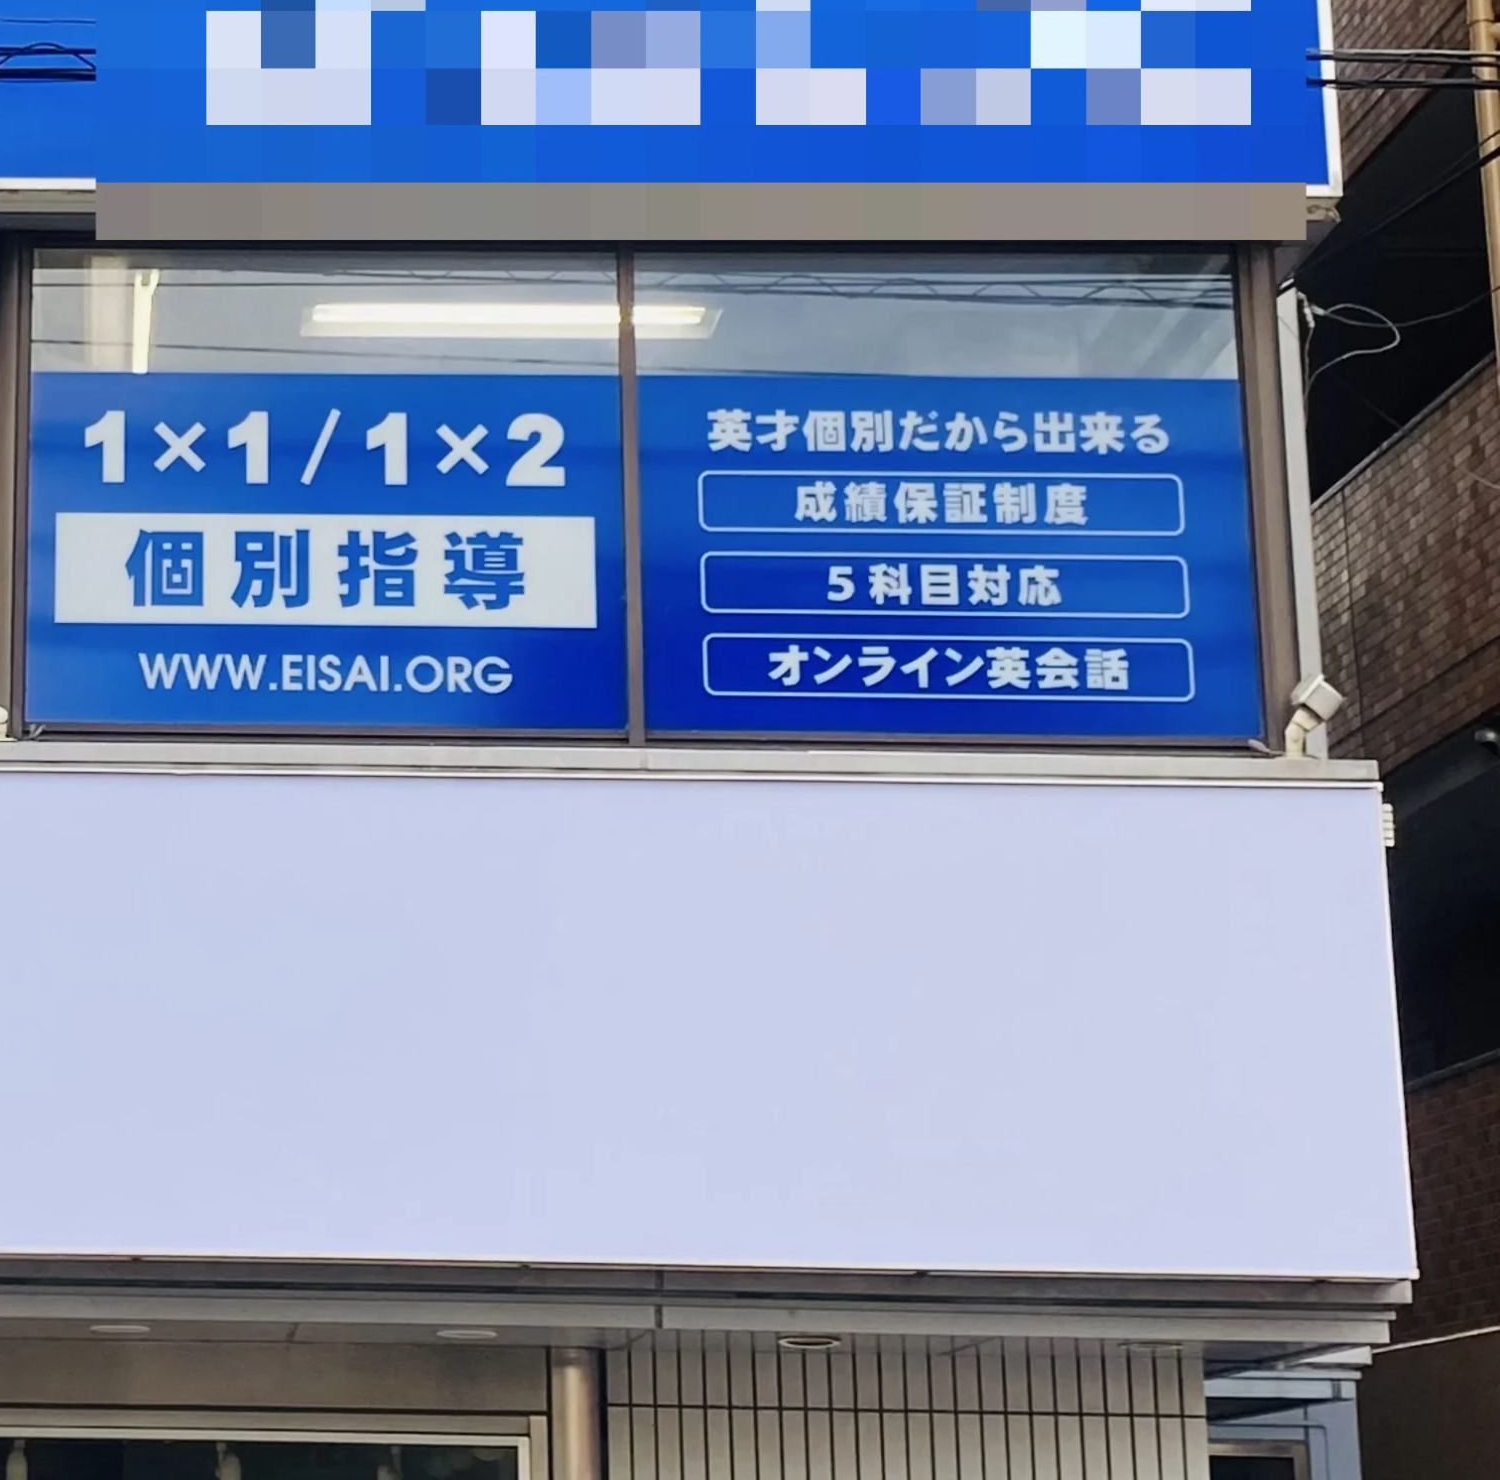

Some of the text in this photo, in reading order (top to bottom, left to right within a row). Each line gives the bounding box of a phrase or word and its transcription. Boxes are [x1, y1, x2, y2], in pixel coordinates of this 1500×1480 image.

[706, 409, 1171, 455] 英才個別だから出来る
[794, 481, 1089, 526] 成績保証制度
[125, 529, 525, 610] 個別指導
[138, 652, 513, 695] WWW.EISAI.ORG
[768, 644, 1130, 691] オンライン英会話
